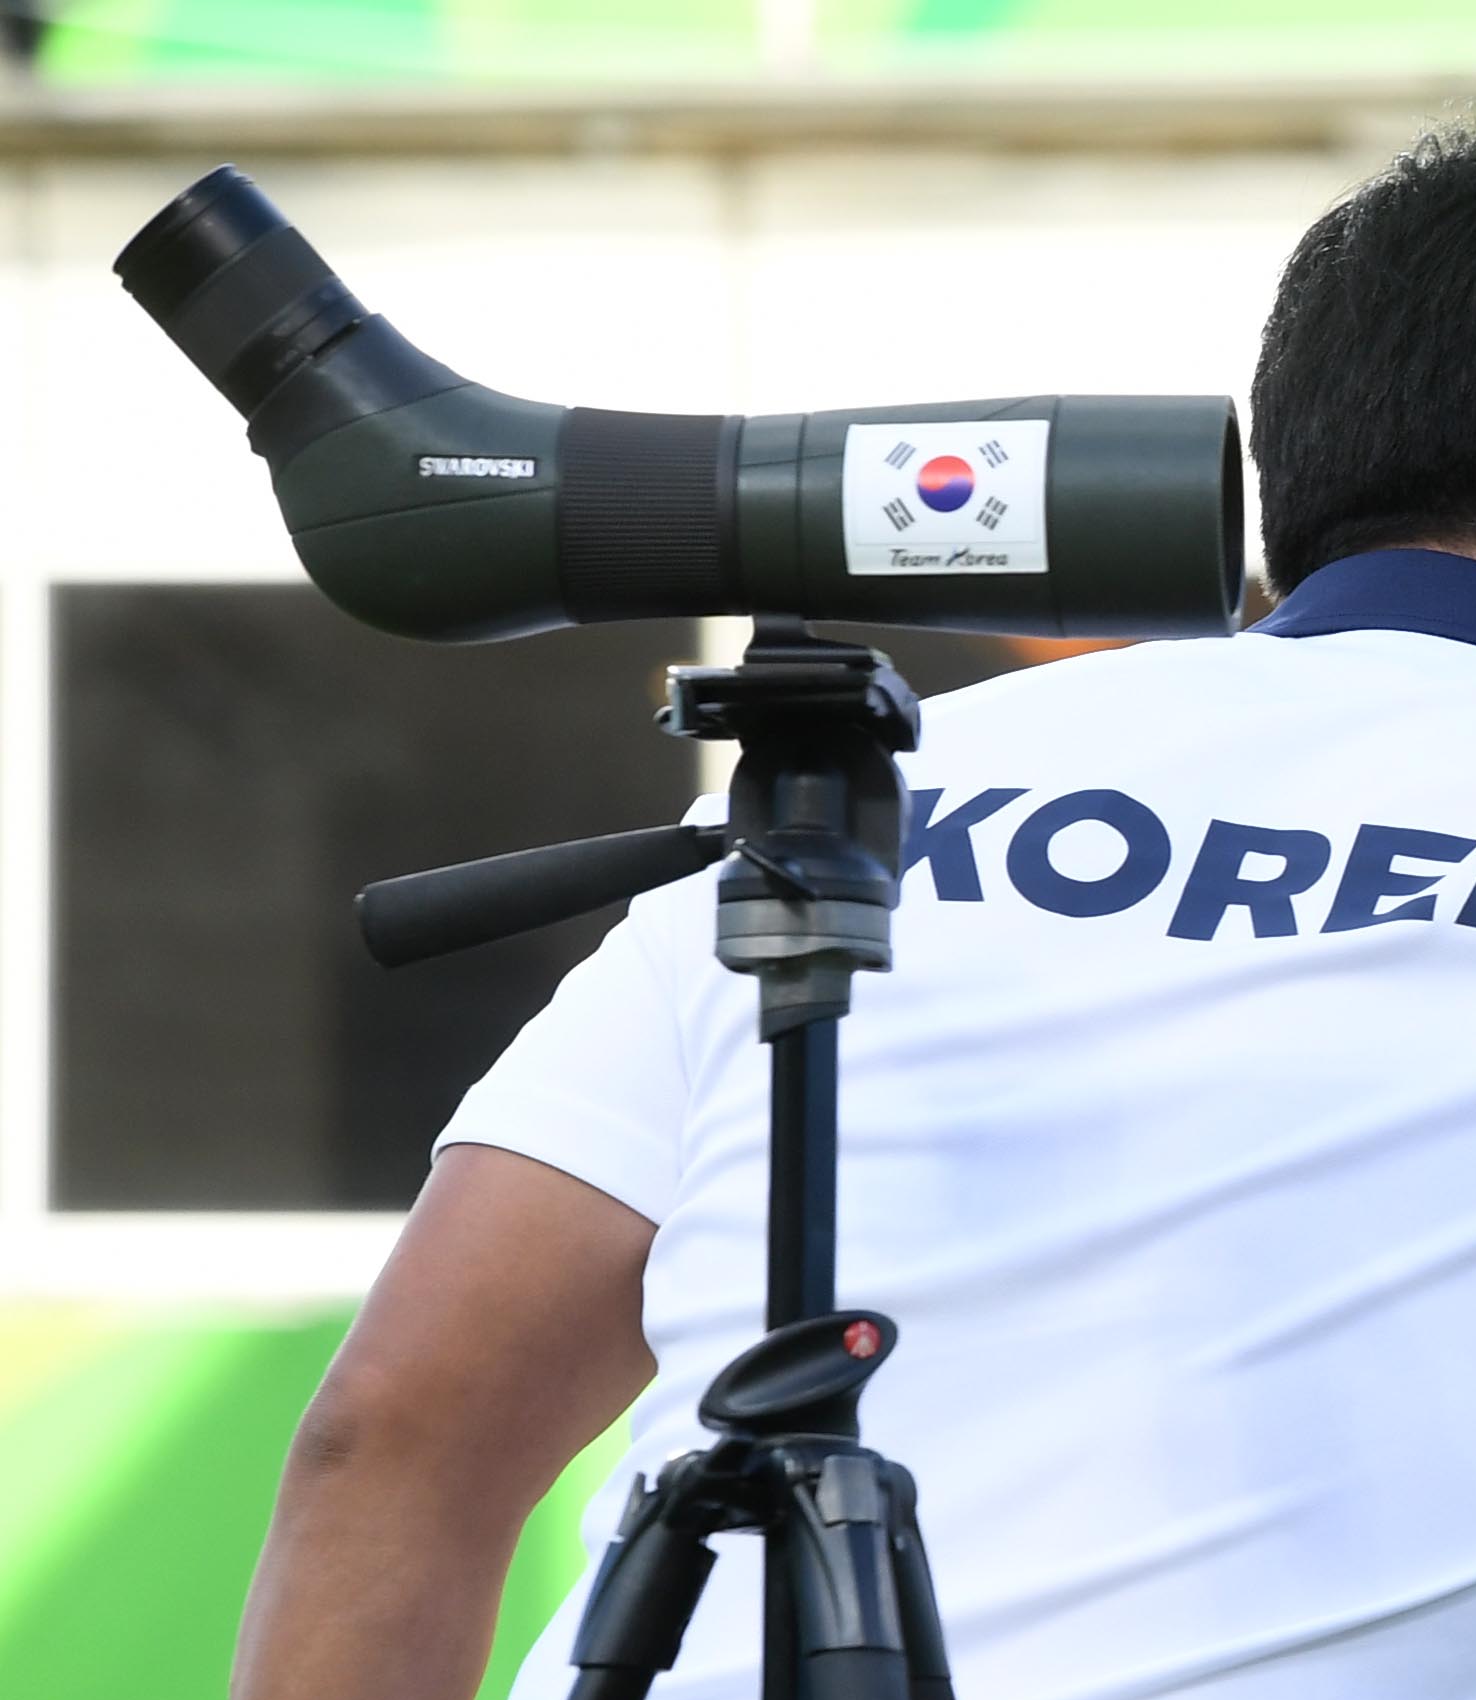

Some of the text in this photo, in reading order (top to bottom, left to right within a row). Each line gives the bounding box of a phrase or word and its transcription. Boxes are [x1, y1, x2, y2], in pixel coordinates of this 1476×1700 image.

[418, 456, 535, 478] SWAROVSKI
[889, 544, 1009, 567] Team Korea
